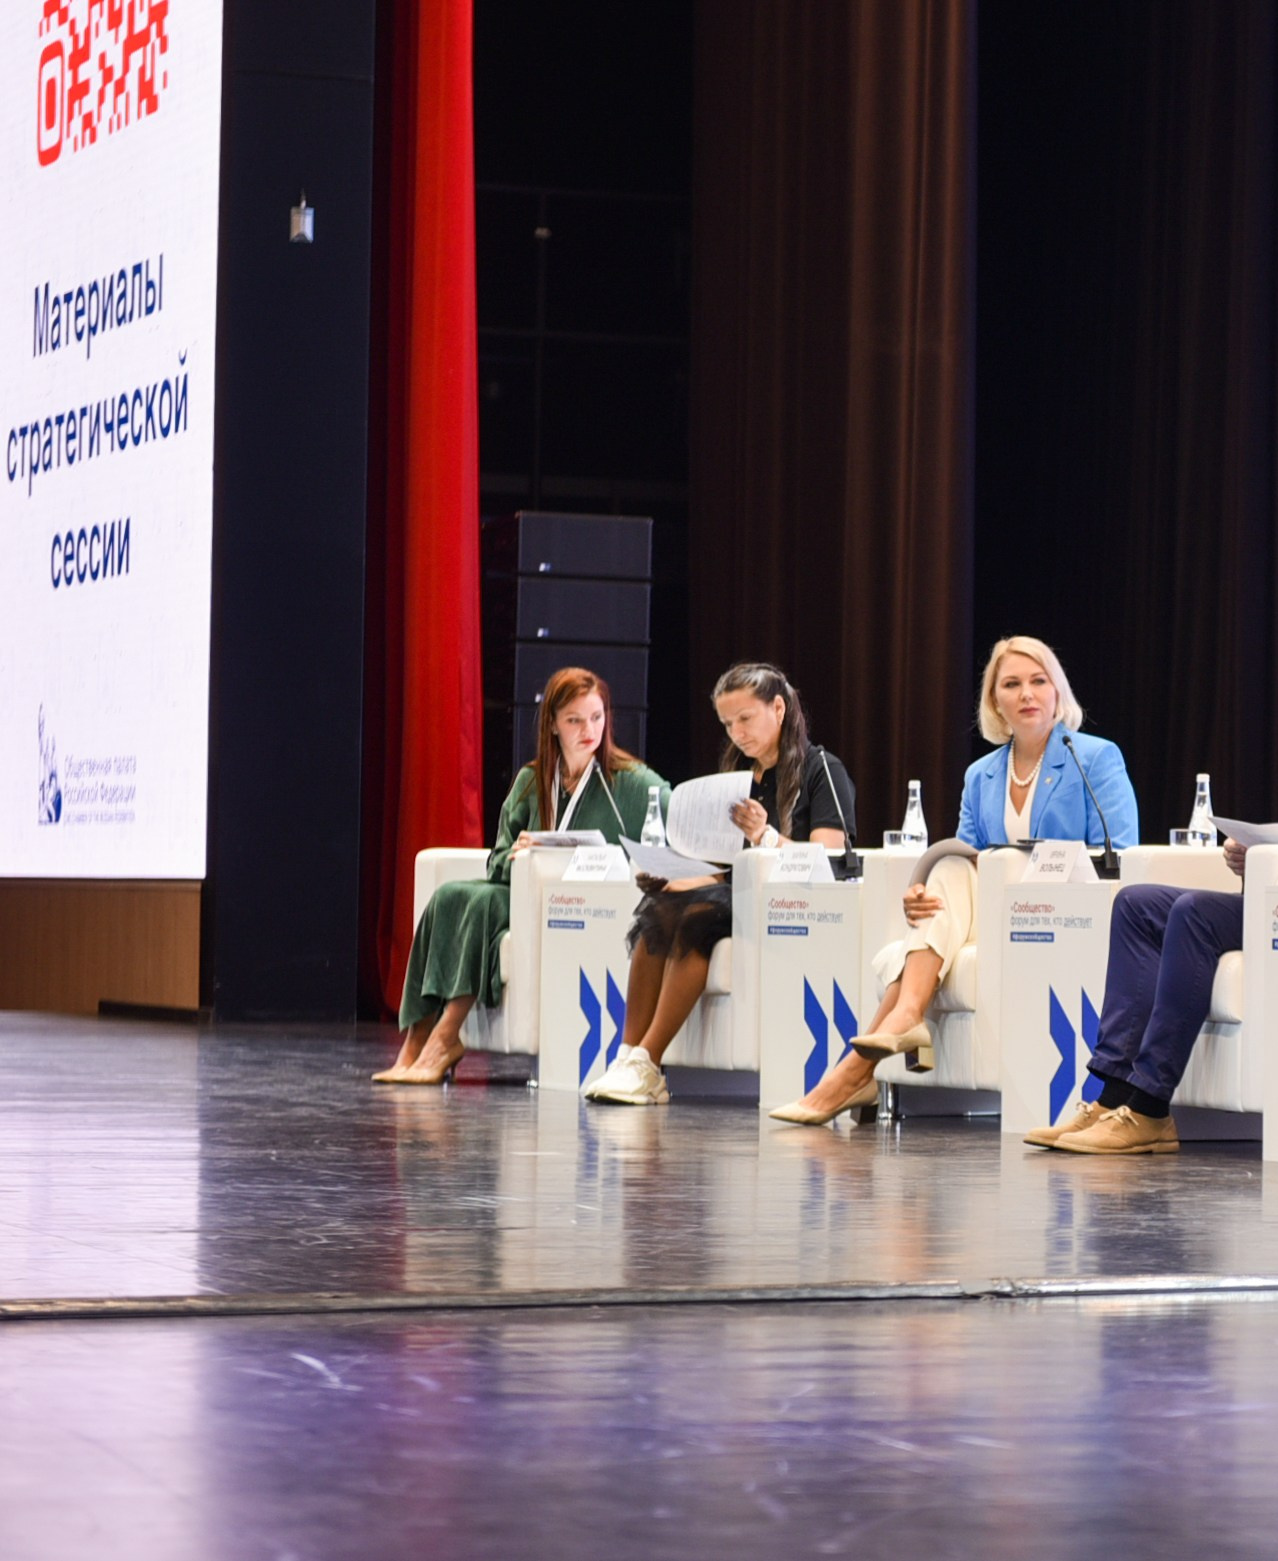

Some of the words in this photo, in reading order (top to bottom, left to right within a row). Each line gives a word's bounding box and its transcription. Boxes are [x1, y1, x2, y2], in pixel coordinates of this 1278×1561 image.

[33, 253, 163, 360] Материалы
[7, 347, 188, 498] стратегической
[51, 516, 131, 589] сессии
[1053, 917, 1062, 926] кто
